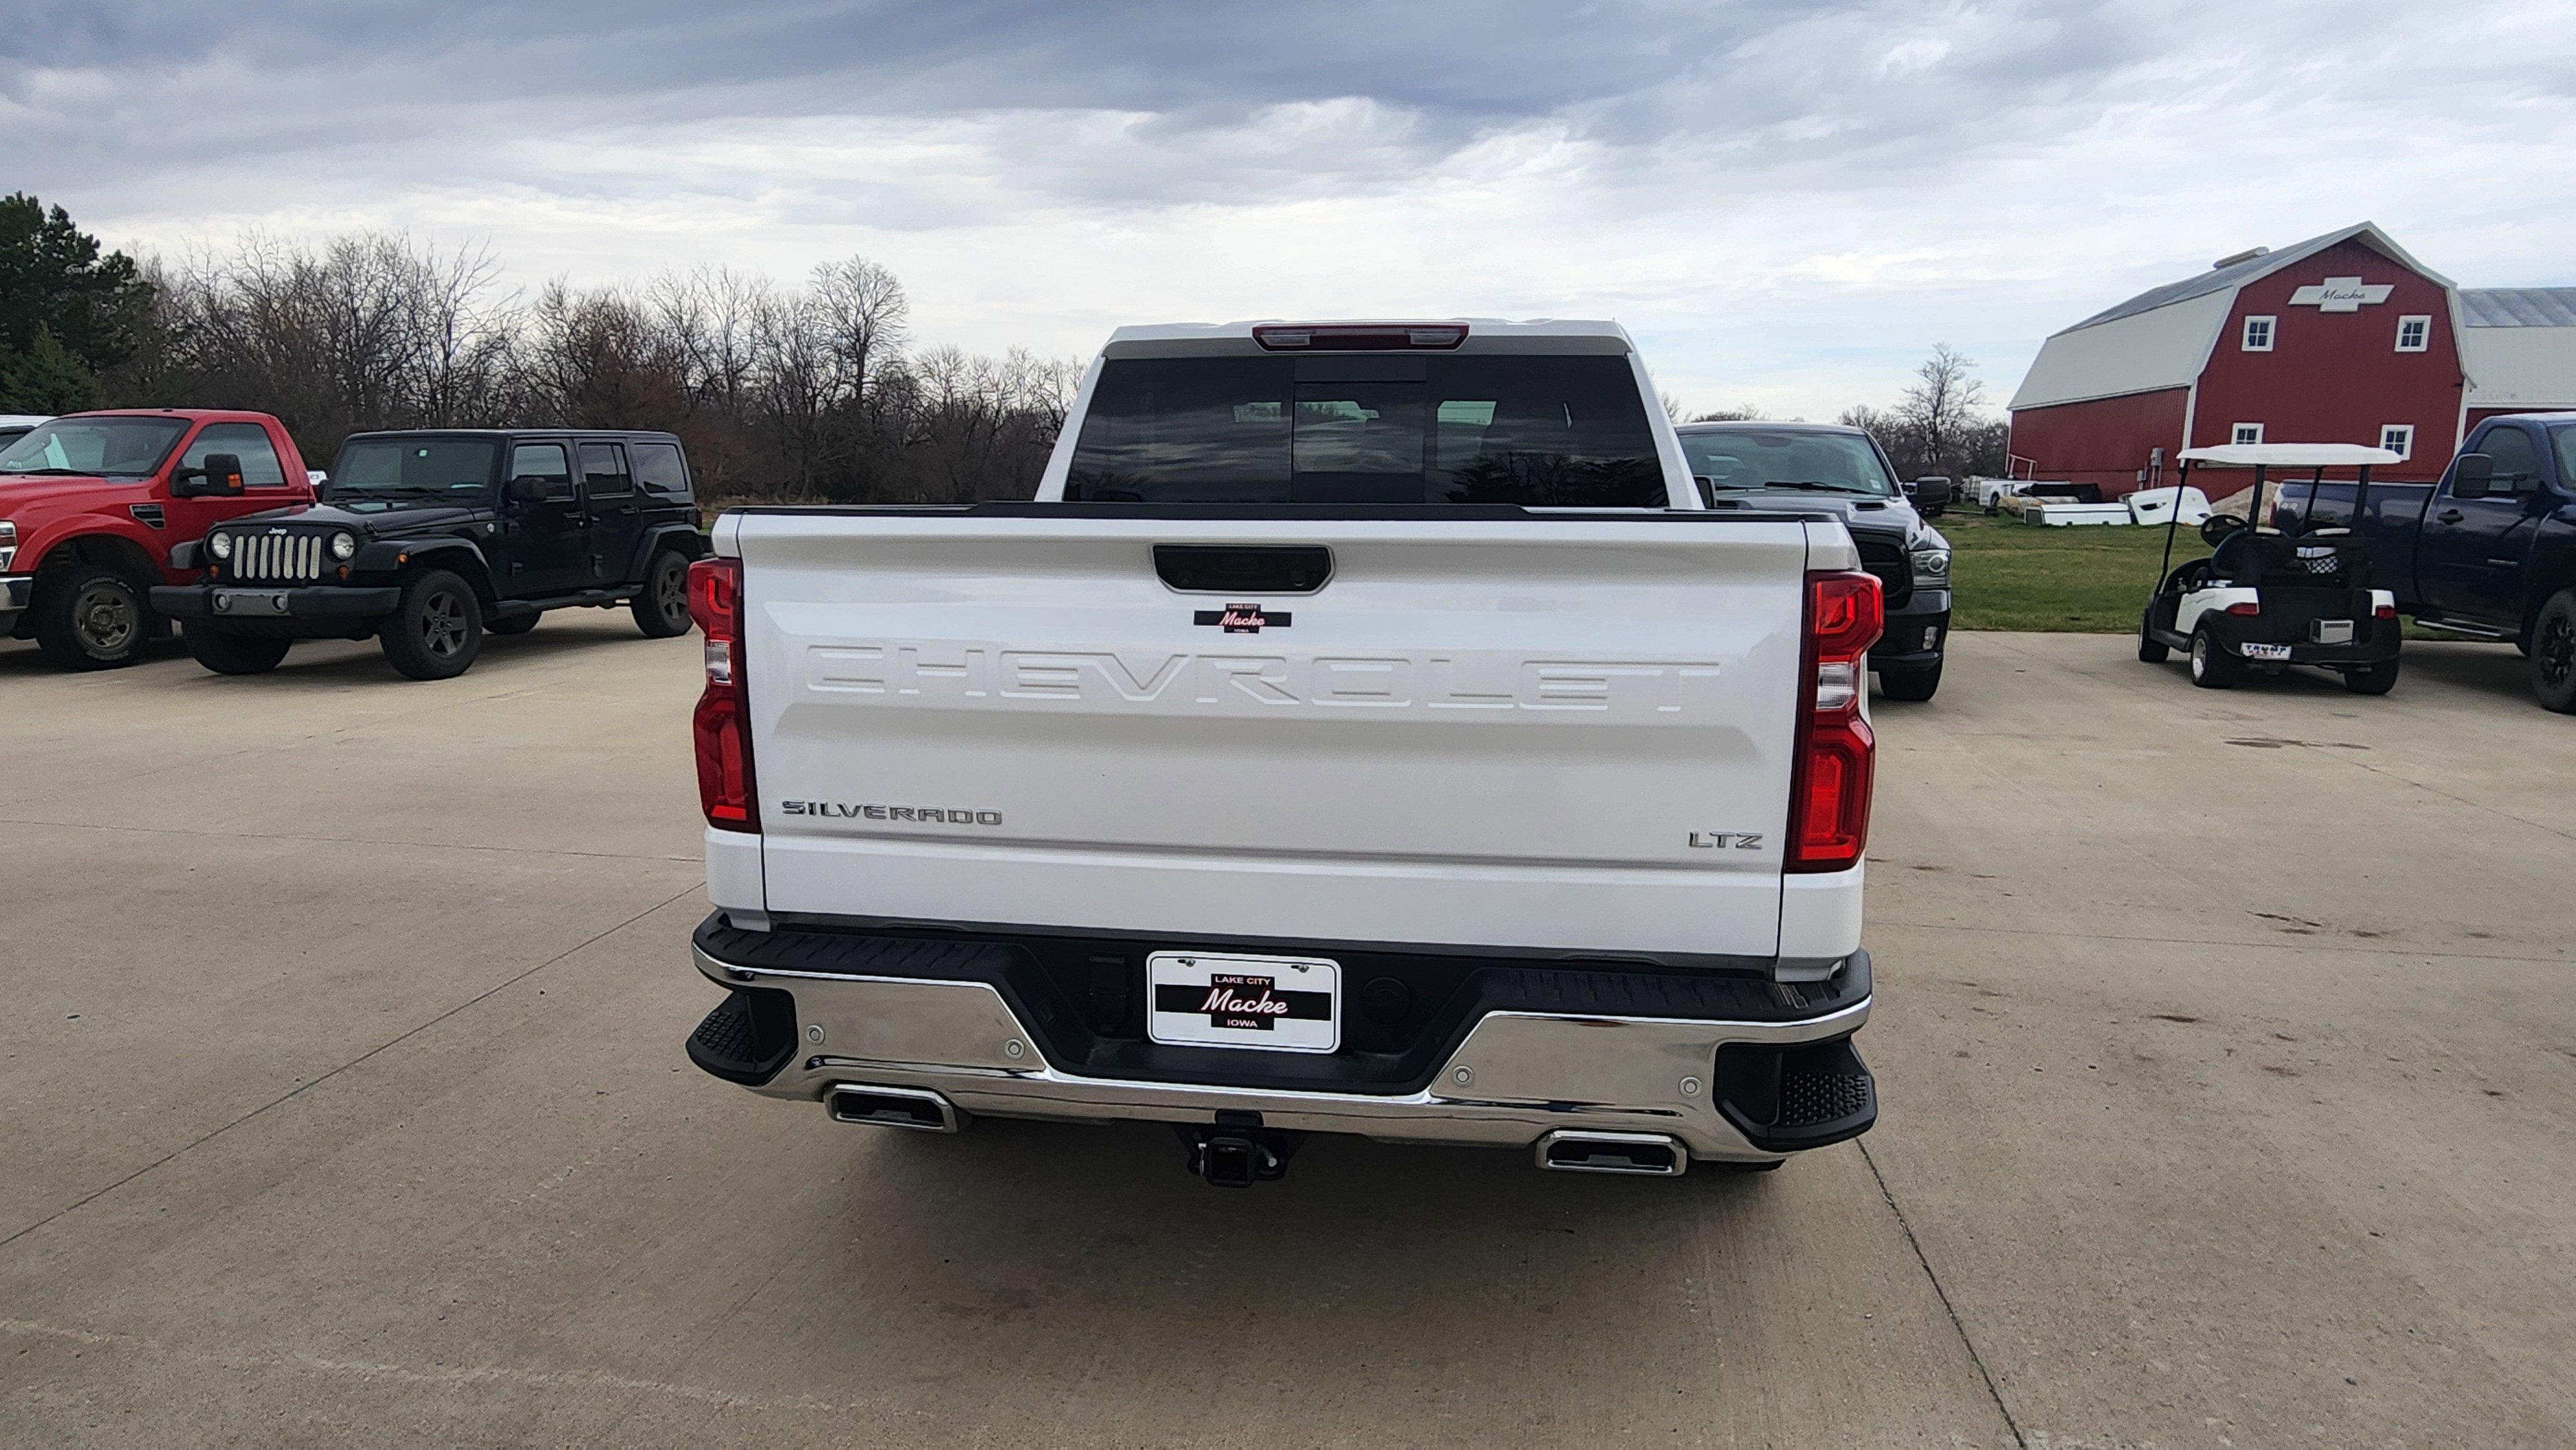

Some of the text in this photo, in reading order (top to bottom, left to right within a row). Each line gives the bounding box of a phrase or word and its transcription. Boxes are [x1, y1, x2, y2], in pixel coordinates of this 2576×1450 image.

[2319, 289, 2366, 300] Macke
[269, 527, 287, 535] Jeep
[1219, 611, 1265, 626] Macke
[806, 645, 1721, 712] CHEVROLET
[781, 800, 1003, 825] SILVERADO
[1689, 831, 1763, 849] LTZ
[1215, 975, 1244, 984] LAKE
[1200, 988, 1288, 1014] Macke
[1227, 1019, 1258, 1028] IOWA
